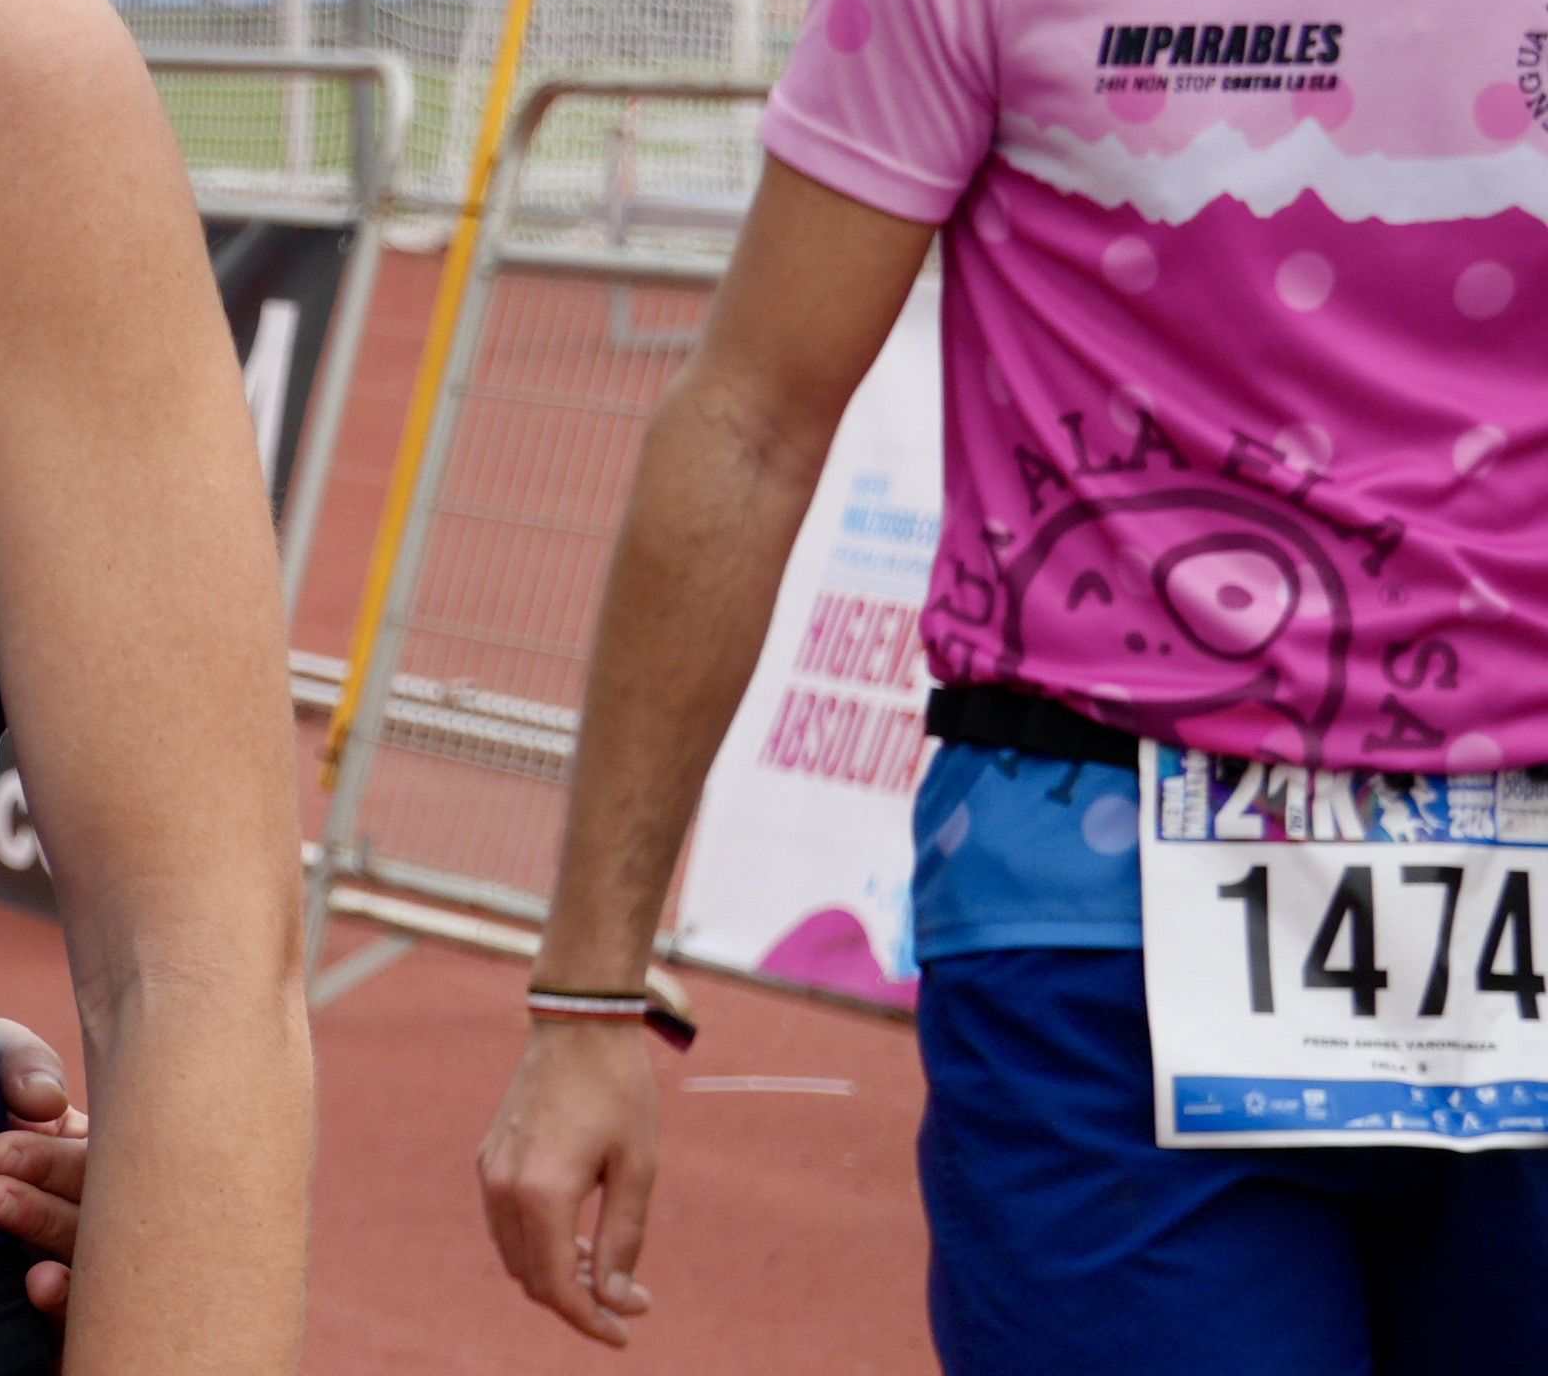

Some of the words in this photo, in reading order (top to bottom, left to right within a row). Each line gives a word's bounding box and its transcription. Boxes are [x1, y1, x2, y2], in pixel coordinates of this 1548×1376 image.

[1098, 23, 1343, 66] IMPARABLES
[1173, 76, 1216, 94] STOP
[1217, 864, 1547, 1021] 1474
